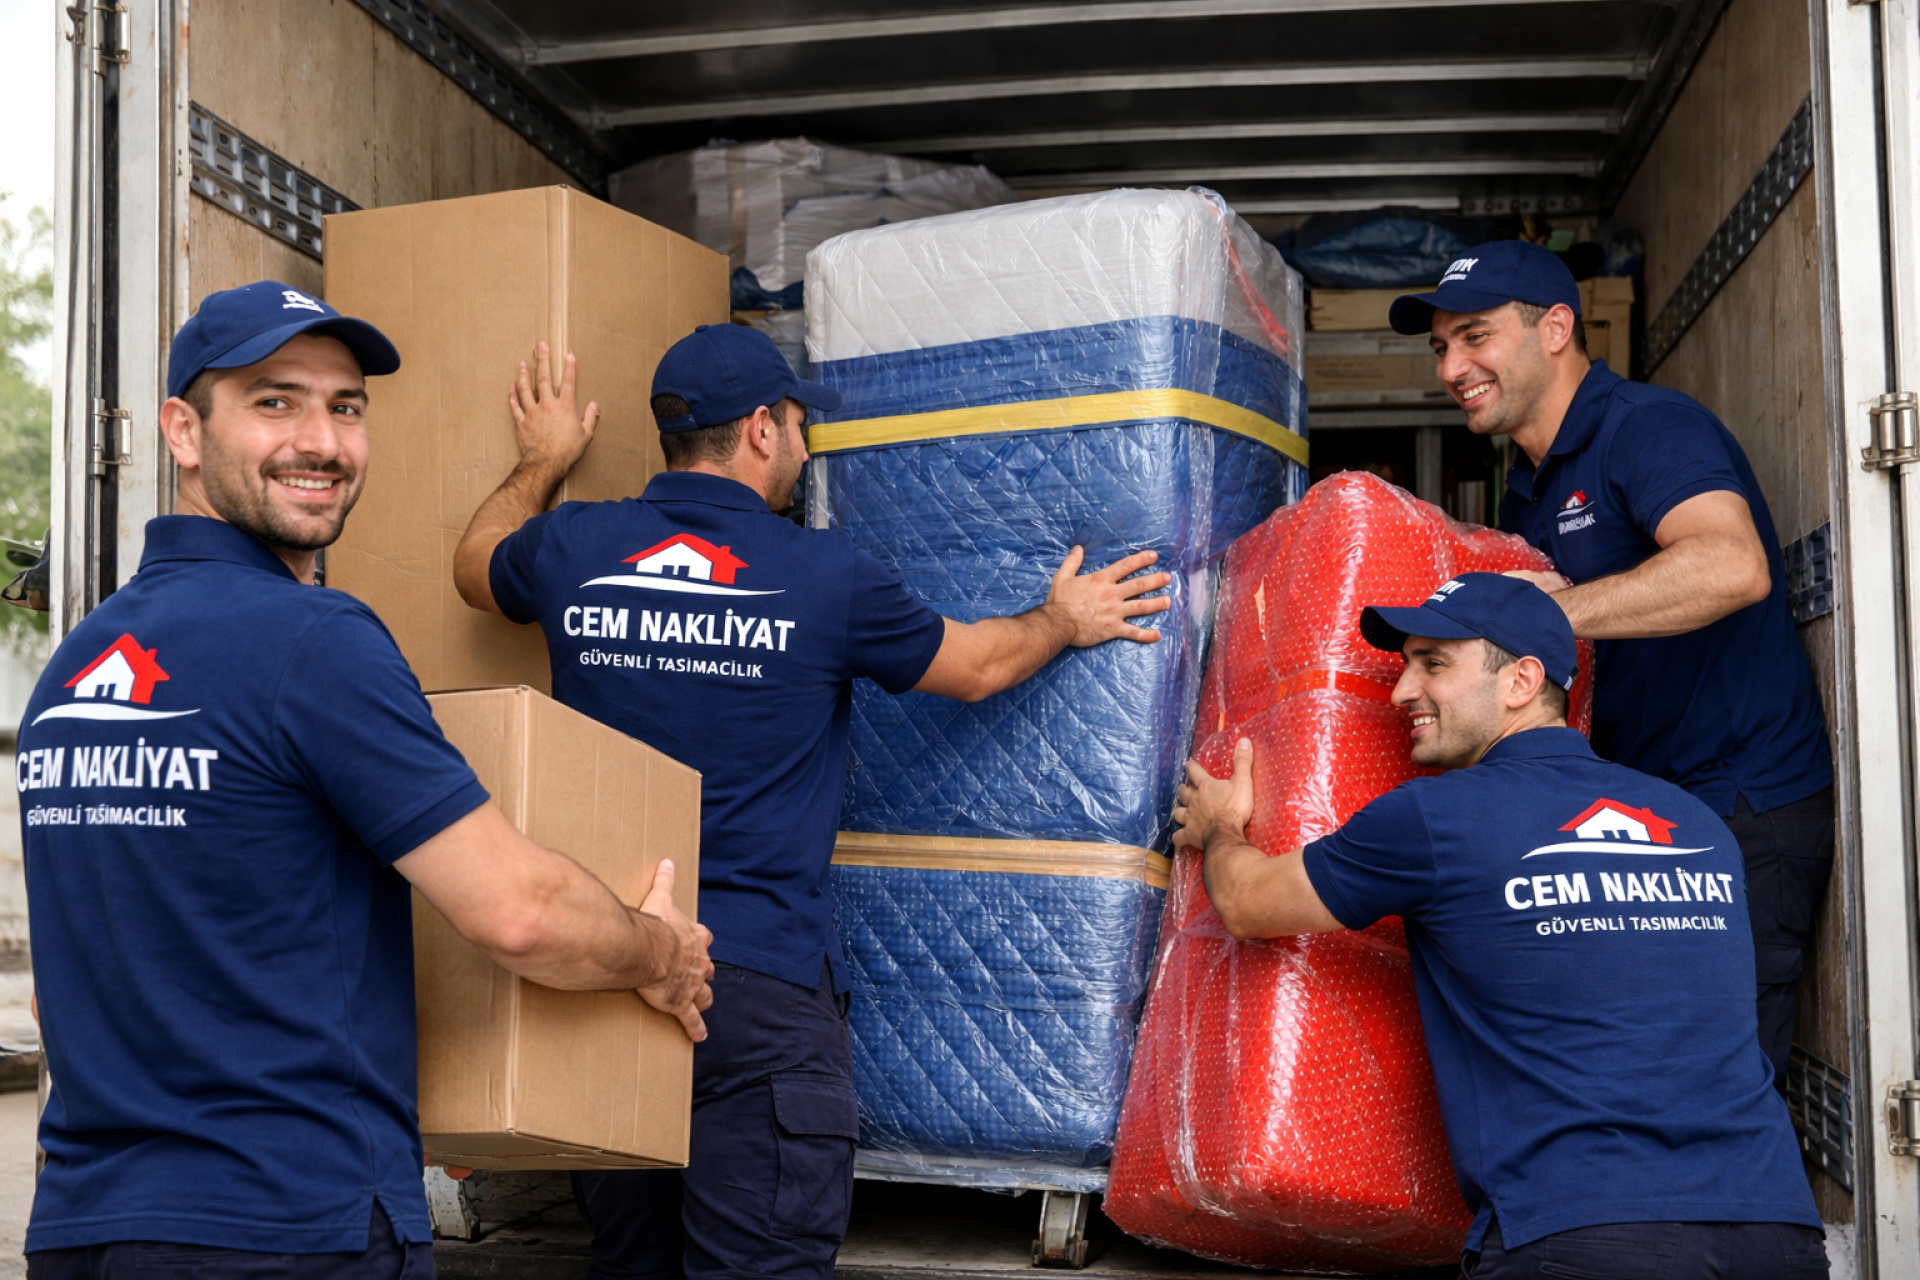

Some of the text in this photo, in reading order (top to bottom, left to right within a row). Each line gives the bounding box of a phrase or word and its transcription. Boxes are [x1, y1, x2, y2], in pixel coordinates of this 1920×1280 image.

[564, 605, 796, 652] CEM NAKLİYAT
[579, 648, 651, 669] GÜVENLİ
[17, 736, 219, 793] CEM NAKLİYAT
[1504, 866, 1734, 910] CEM NAKLİYAT
[1536, 914, 1626, 936] GÜVENLİ
